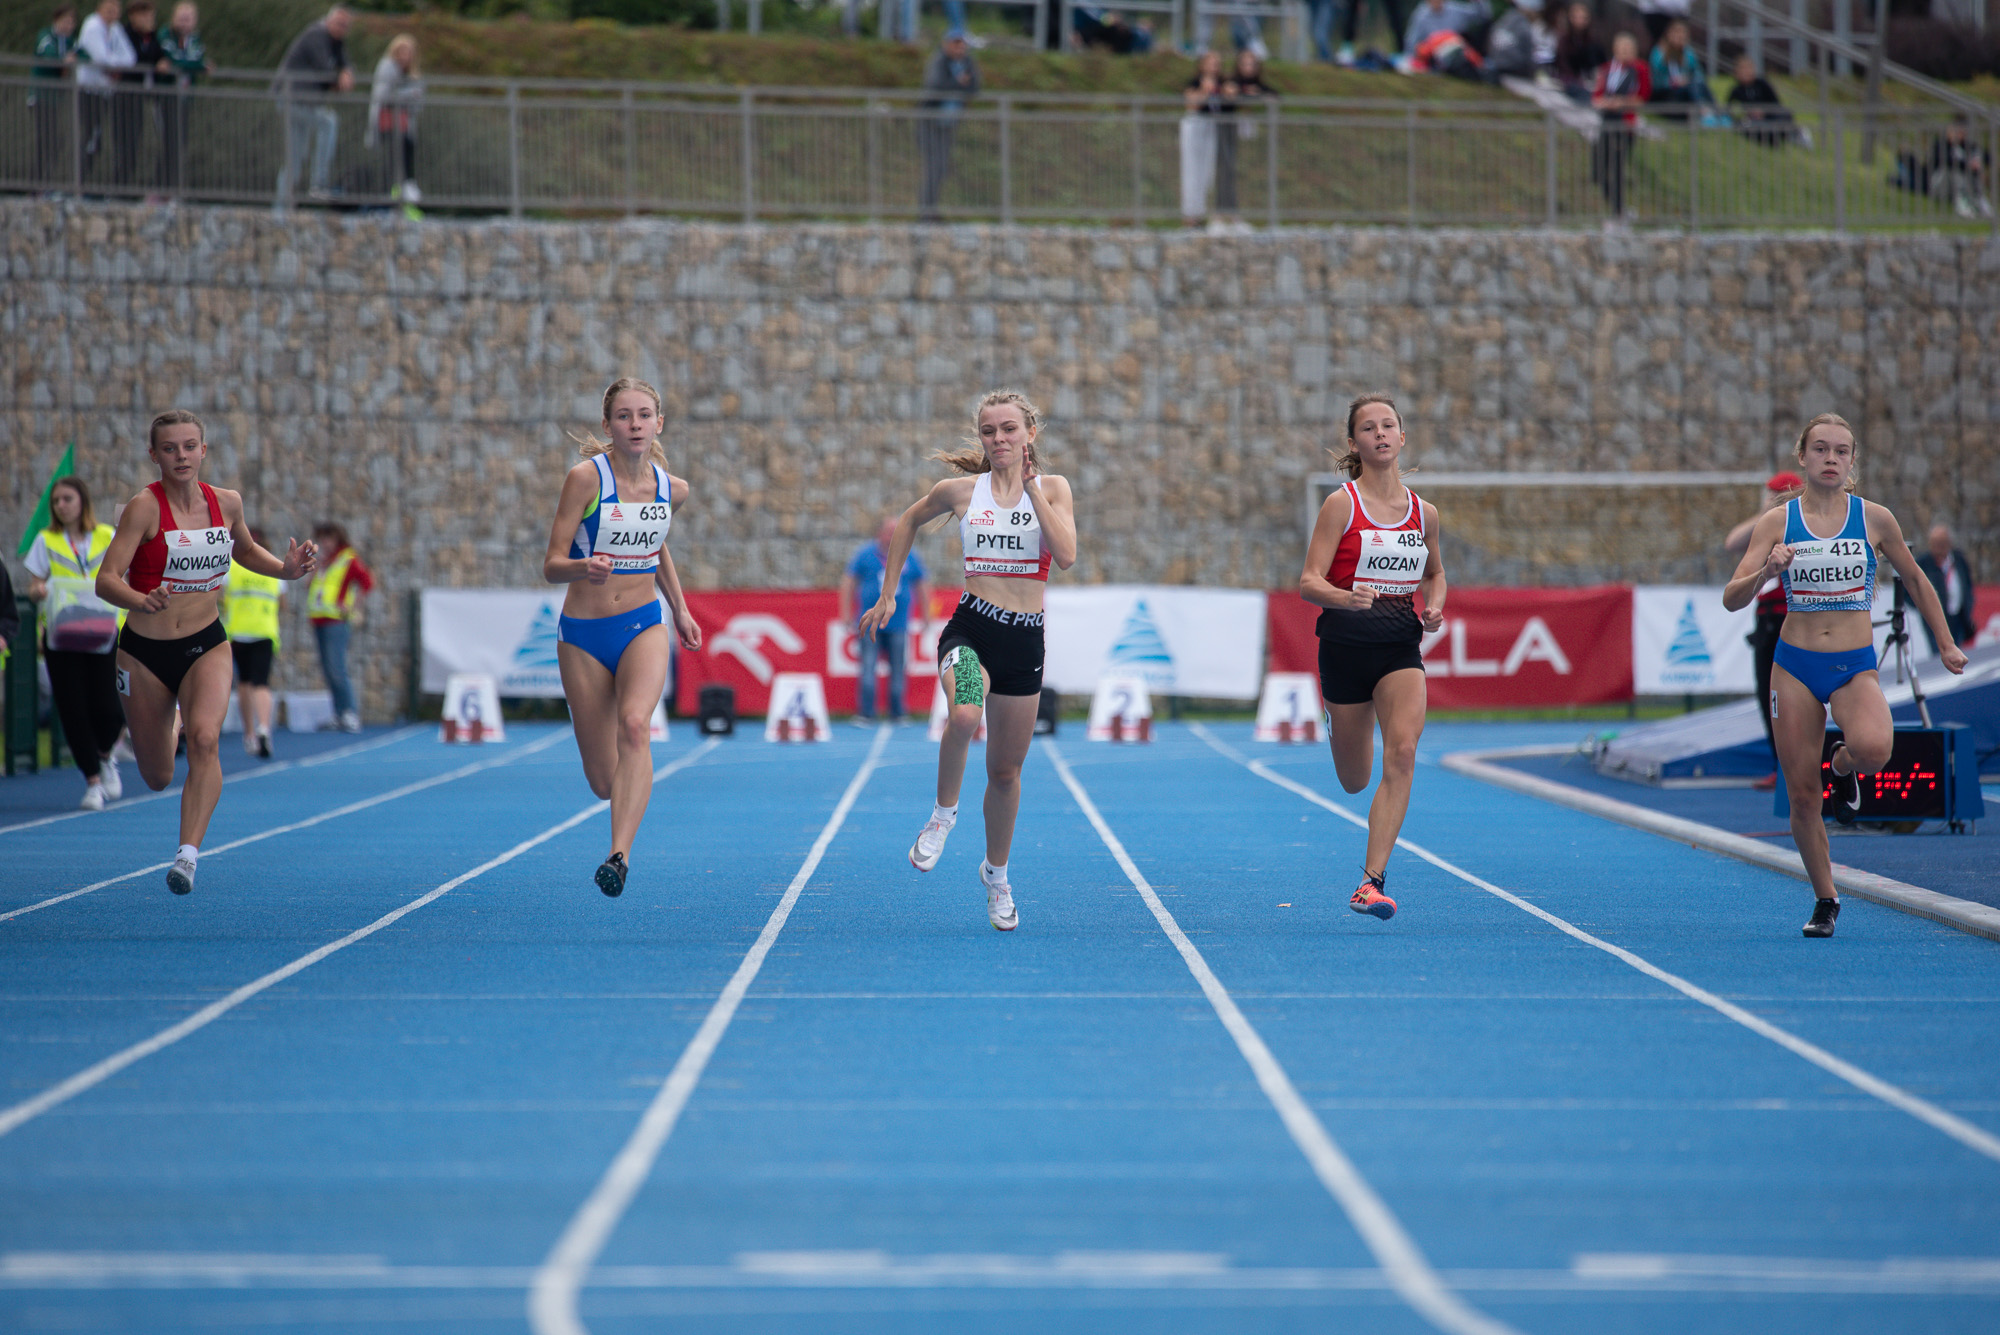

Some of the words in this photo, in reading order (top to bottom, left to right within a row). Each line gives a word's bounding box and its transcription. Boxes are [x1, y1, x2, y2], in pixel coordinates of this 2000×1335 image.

[640, 505, 667, 520] 633
[1010, 511, 1032, 526] 89
[609, 531, 659, 549] ZAJĄC
[976, 533, 1025, 550] PYTEL
[1397, 533, 1424, 547] 485
[1830, 541, 1862, 556] 412
[1794, 546, 1824, 556] OTALbet
[168, 552, 230, 571] NOWACKA
[613, 560, 639, 569] RPACZ
[1009, 565, 1027, 573] 2021
[1366, 556, 1420, 571] KOZAN
[1793, 564, 1864, 582] JAGIEŁŁO
[970, 597, 1013, 625] NIKE
[1012, 612, 1044, 627] PRO
[944, 652, 954, 671] 3
[118, 670, 125, 691] 5
[461, 689, 482, 721] 6
[785, 690, 807, 719] 4
[1111, 690, 1134, 721] 2
